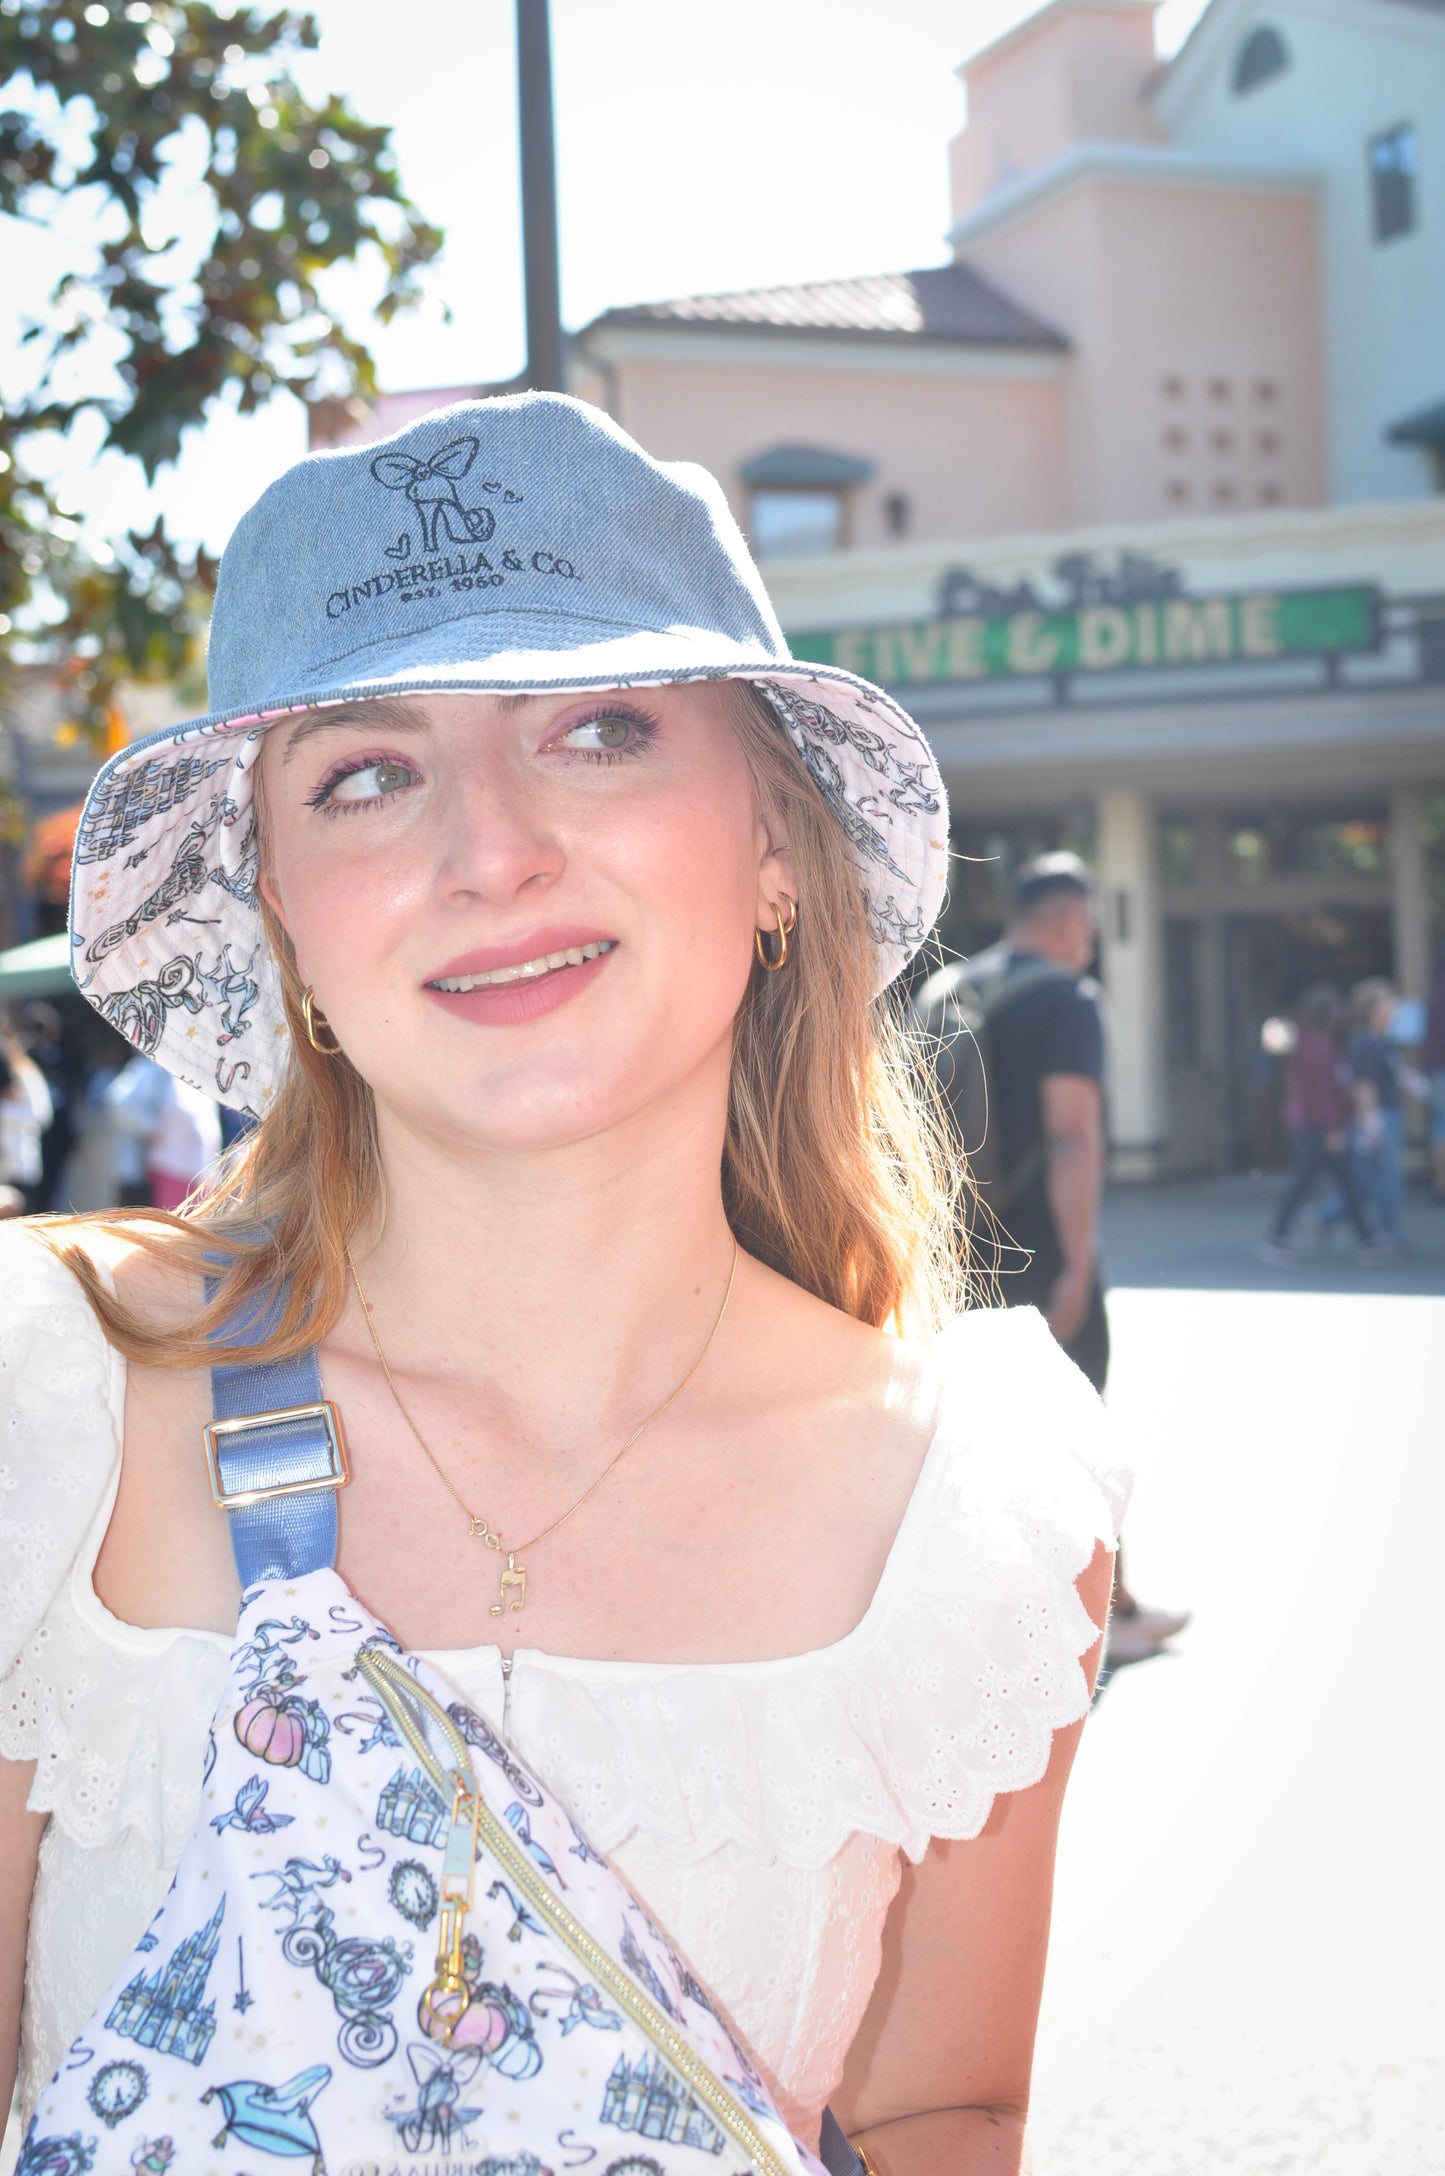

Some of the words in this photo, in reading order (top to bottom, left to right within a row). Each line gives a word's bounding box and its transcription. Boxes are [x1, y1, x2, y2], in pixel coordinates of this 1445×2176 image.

[325, 552, 493, 618] CINDERELLA
[502, 549, 526, 571] &
[449, 574, 505, 592] 1950
[833, 620, 989, 684] FIVE
[1007, 611, 1063, 674] &
[1078, 597, 1285, 668] DIME
